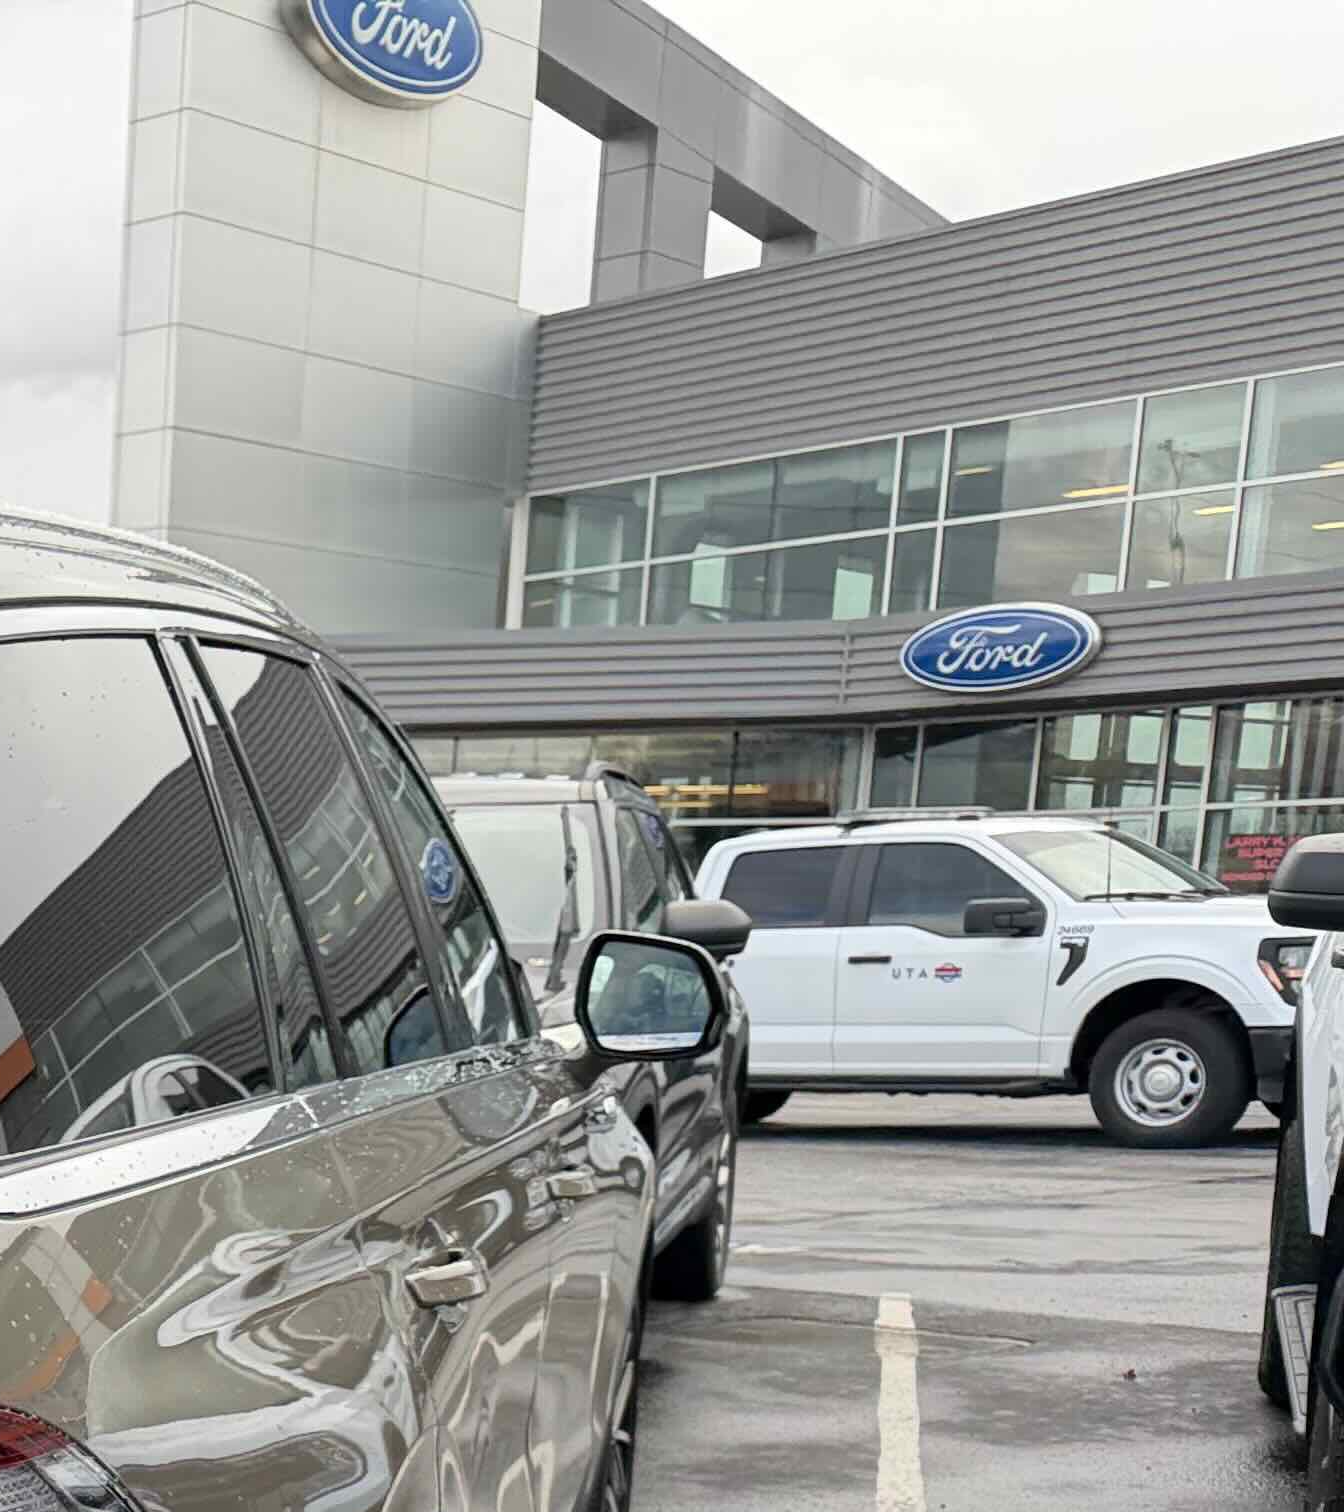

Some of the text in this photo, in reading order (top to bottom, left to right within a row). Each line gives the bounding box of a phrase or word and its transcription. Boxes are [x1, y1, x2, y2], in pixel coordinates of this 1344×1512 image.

[351, 0, 457, 69] Ford
[936, 625, 1047, 674] Ford
[892, 967, 929, 980] UTA
